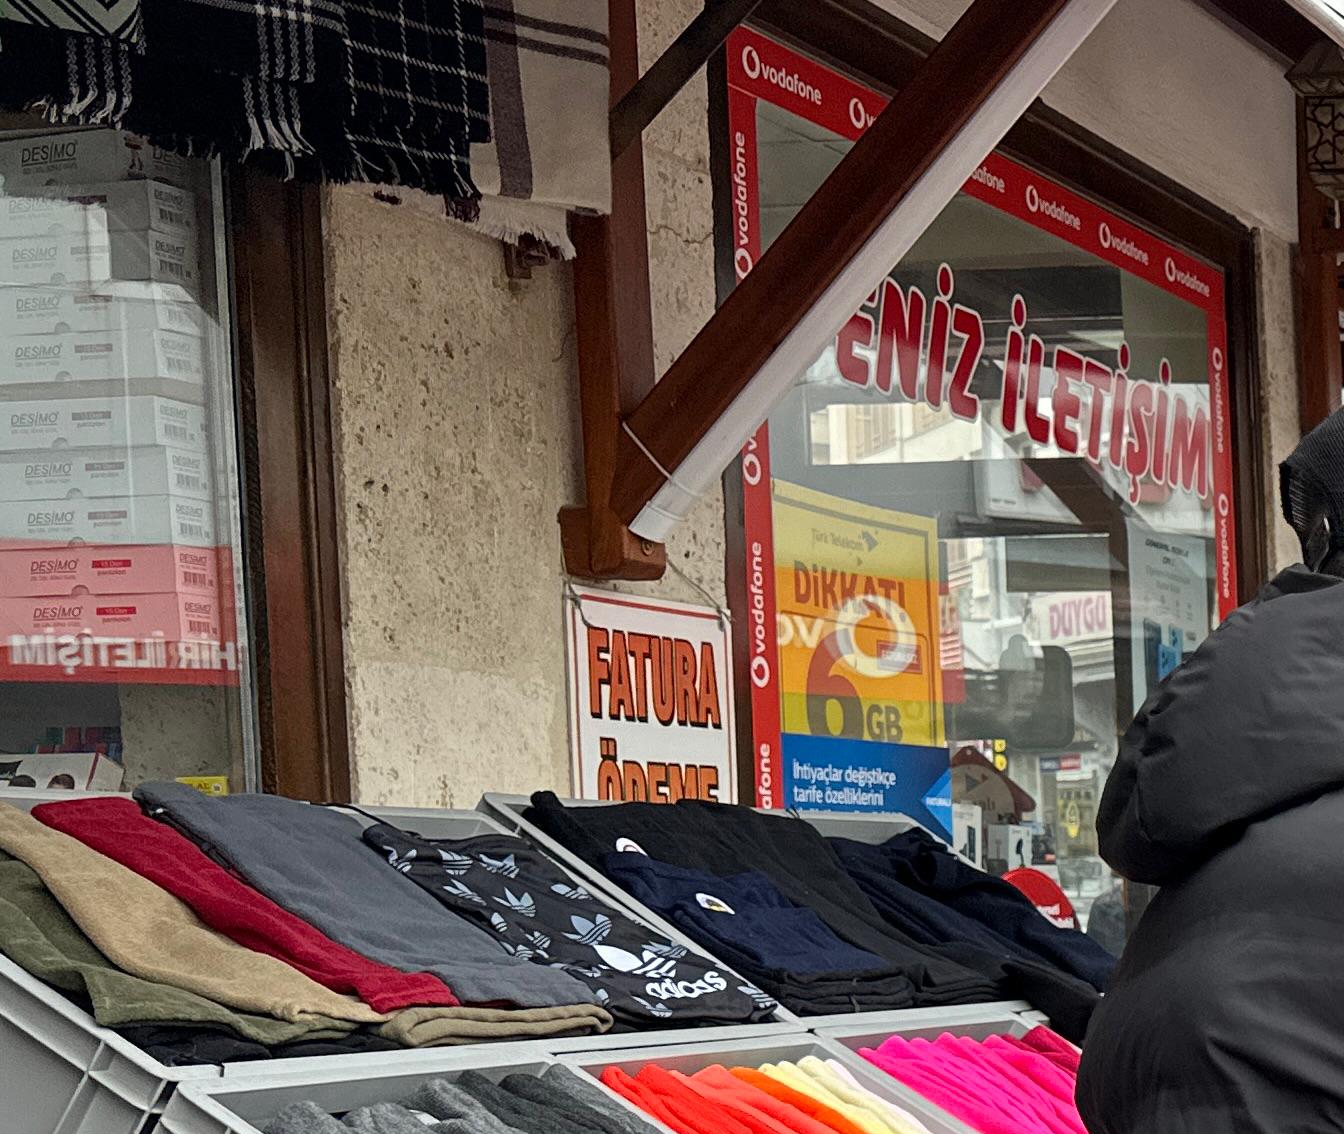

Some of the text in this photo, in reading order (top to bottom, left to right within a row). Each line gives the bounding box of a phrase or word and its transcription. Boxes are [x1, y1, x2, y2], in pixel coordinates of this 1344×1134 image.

[761, 62, 823, 106] vodafone
[734, 131, 749, 246] vodafone
[1039, 199, 1082, 231] vodafone
[1111, 236, 1150, 266] vodafone
[1175, 267, 1211, 298] vodafone
[835, 262, 1214, 506] ENİZ İLETİŞİM
[749, 541, 766, 652] vodafone
[1049, 594, 1107, 641] DUYGU
[587, 625, 722, 730] FATURA
[866, 703, 904, 744] GB
[792, 758, 842, 786] İhtiyaçlar
[793, 785, 823, 804] tarife
[645, 971, 728, 1000] adidas
